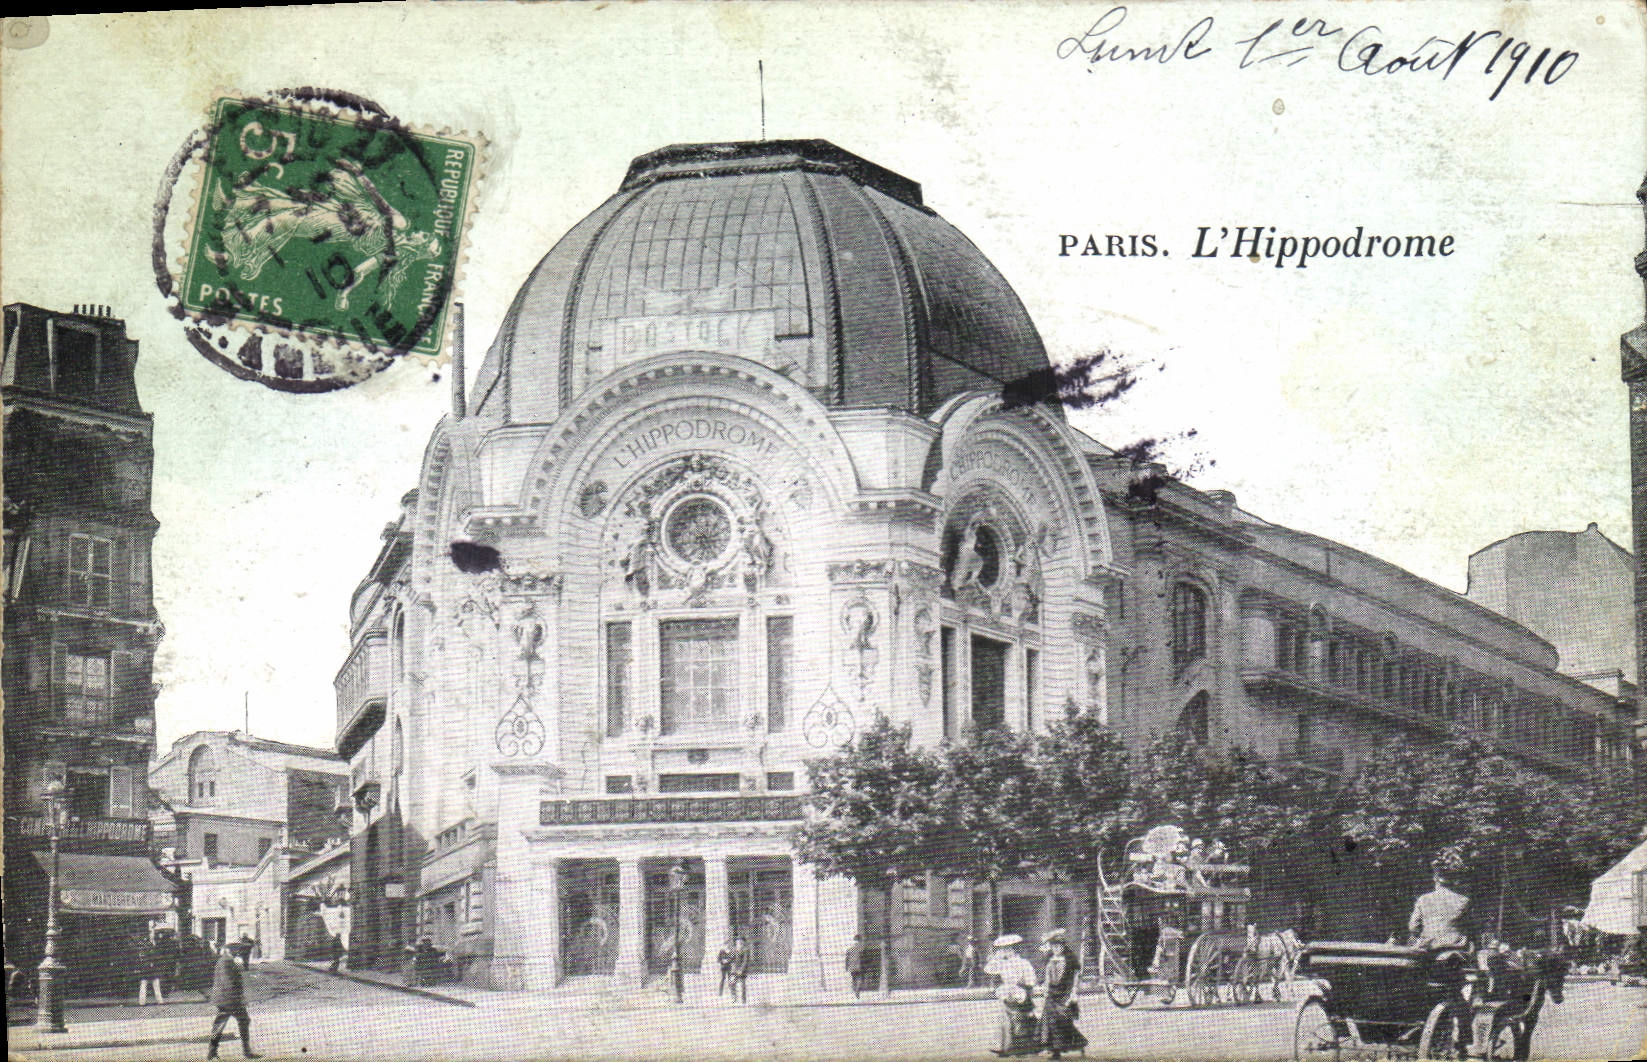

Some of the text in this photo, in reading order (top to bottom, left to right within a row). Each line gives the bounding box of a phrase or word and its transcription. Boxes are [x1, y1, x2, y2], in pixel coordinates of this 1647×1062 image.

[1484, 36, 1580, 101] 1910
[200, 284, 283, 316] POSTES
[417, 263, 445, 345] FRANÇAE
[613, 418, 778, 468] L'HIPPODROME
